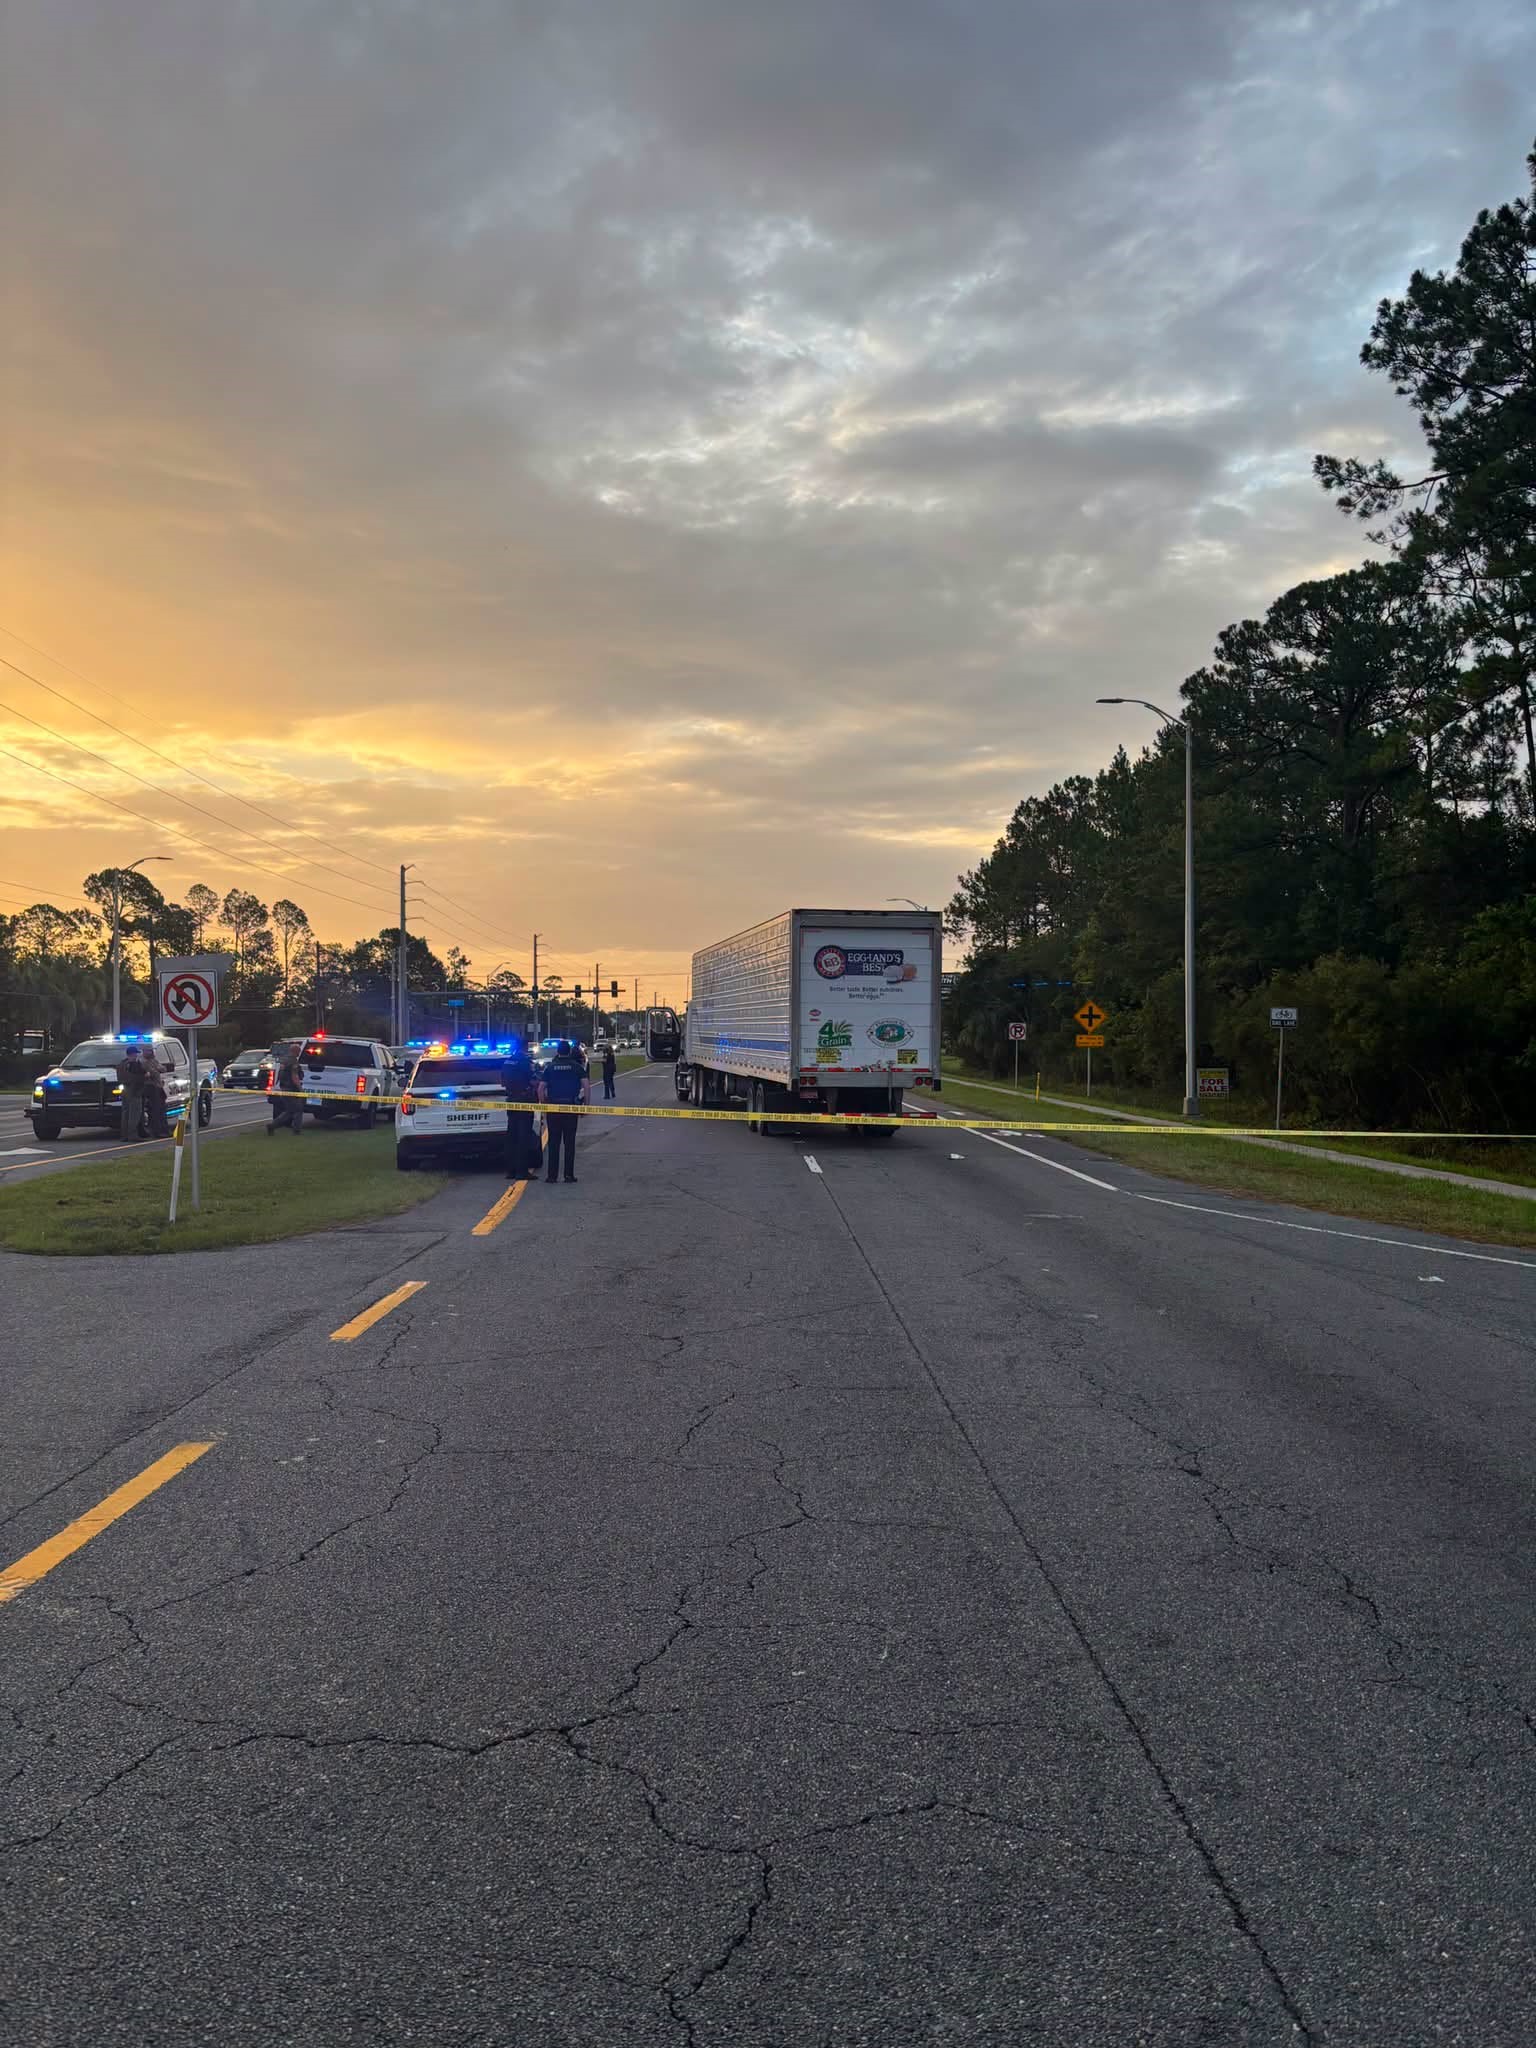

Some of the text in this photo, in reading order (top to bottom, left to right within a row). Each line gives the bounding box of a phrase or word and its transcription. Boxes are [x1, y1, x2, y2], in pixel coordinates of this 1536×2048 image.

[863, 963, 886, 972] BEST
[818, 1020, 834, 1038] 4
[822, 1037, 847, 1046] Grain
[446, 1113, 490, 1121] SHERIFF
